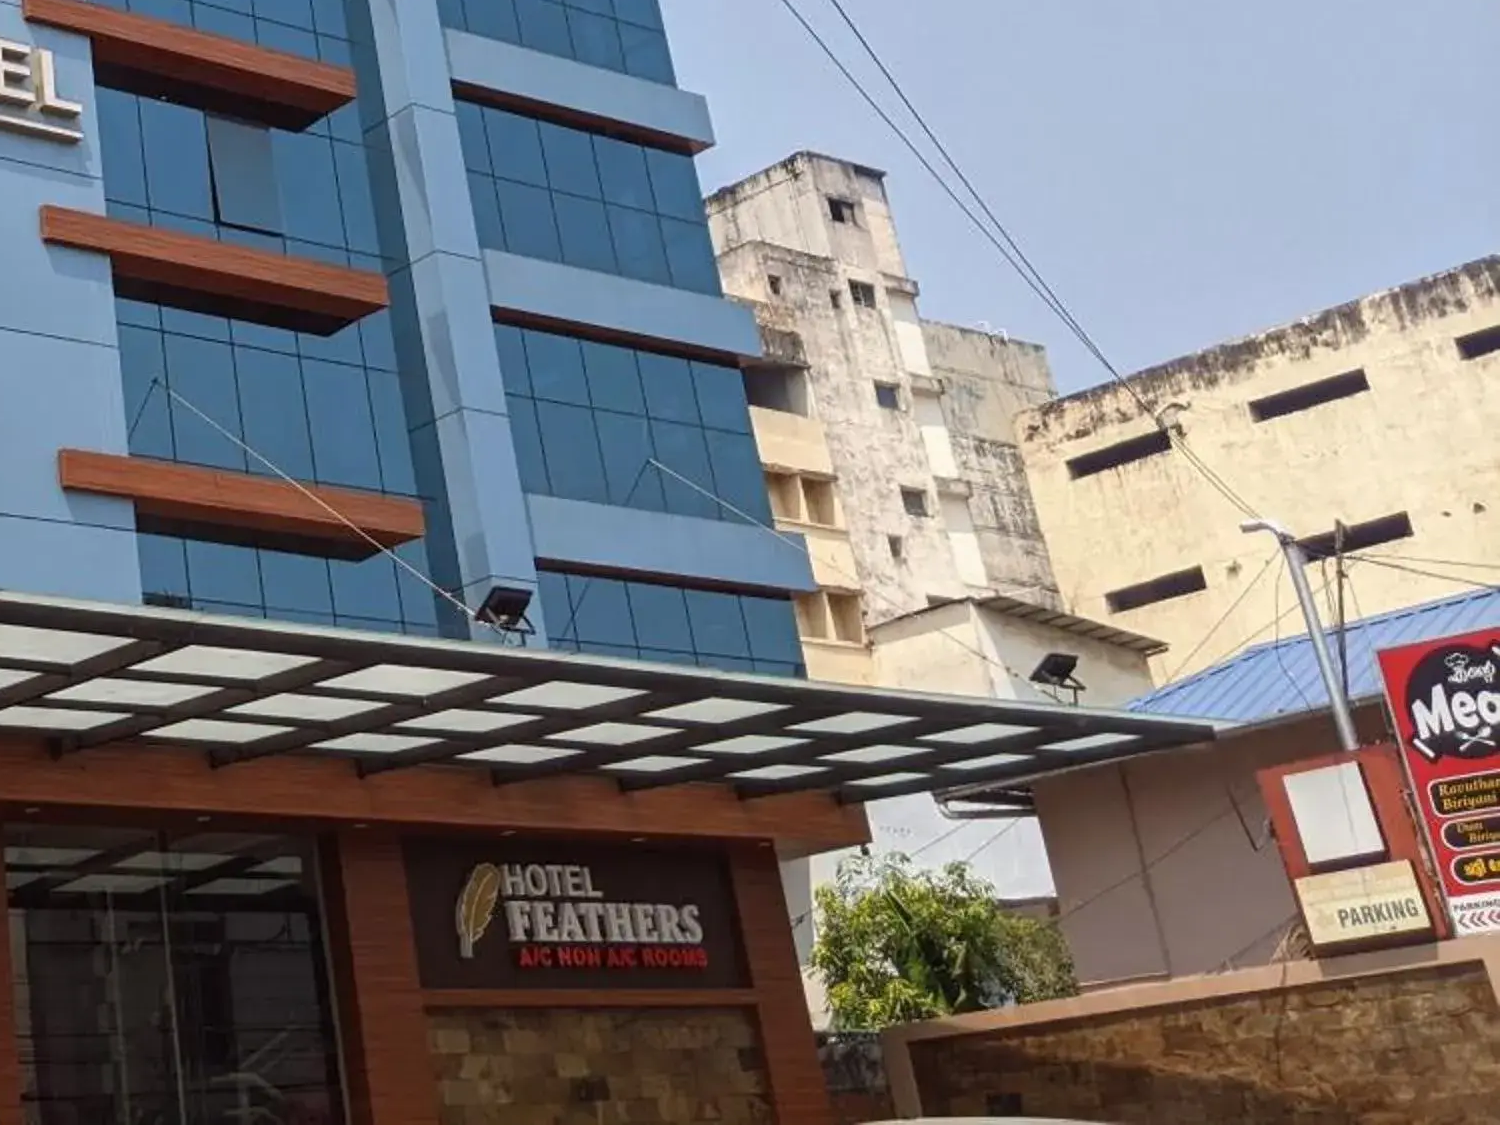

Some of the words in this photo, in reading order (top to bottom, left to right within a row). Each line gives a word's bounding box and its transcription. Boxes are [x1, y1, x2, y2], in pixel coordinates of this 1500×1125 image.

[501, 863, 604, 898] HOTEL
[505, 900, 703, 943] FEATHERS
[1337, 897, 1419, 928] PARKING
[519, 947, 551, 967] A/C
[558, 948, 600, 968] NON
[607, 948, 638, 968] A/C
[642, 949, 708, 969] ROOMS
